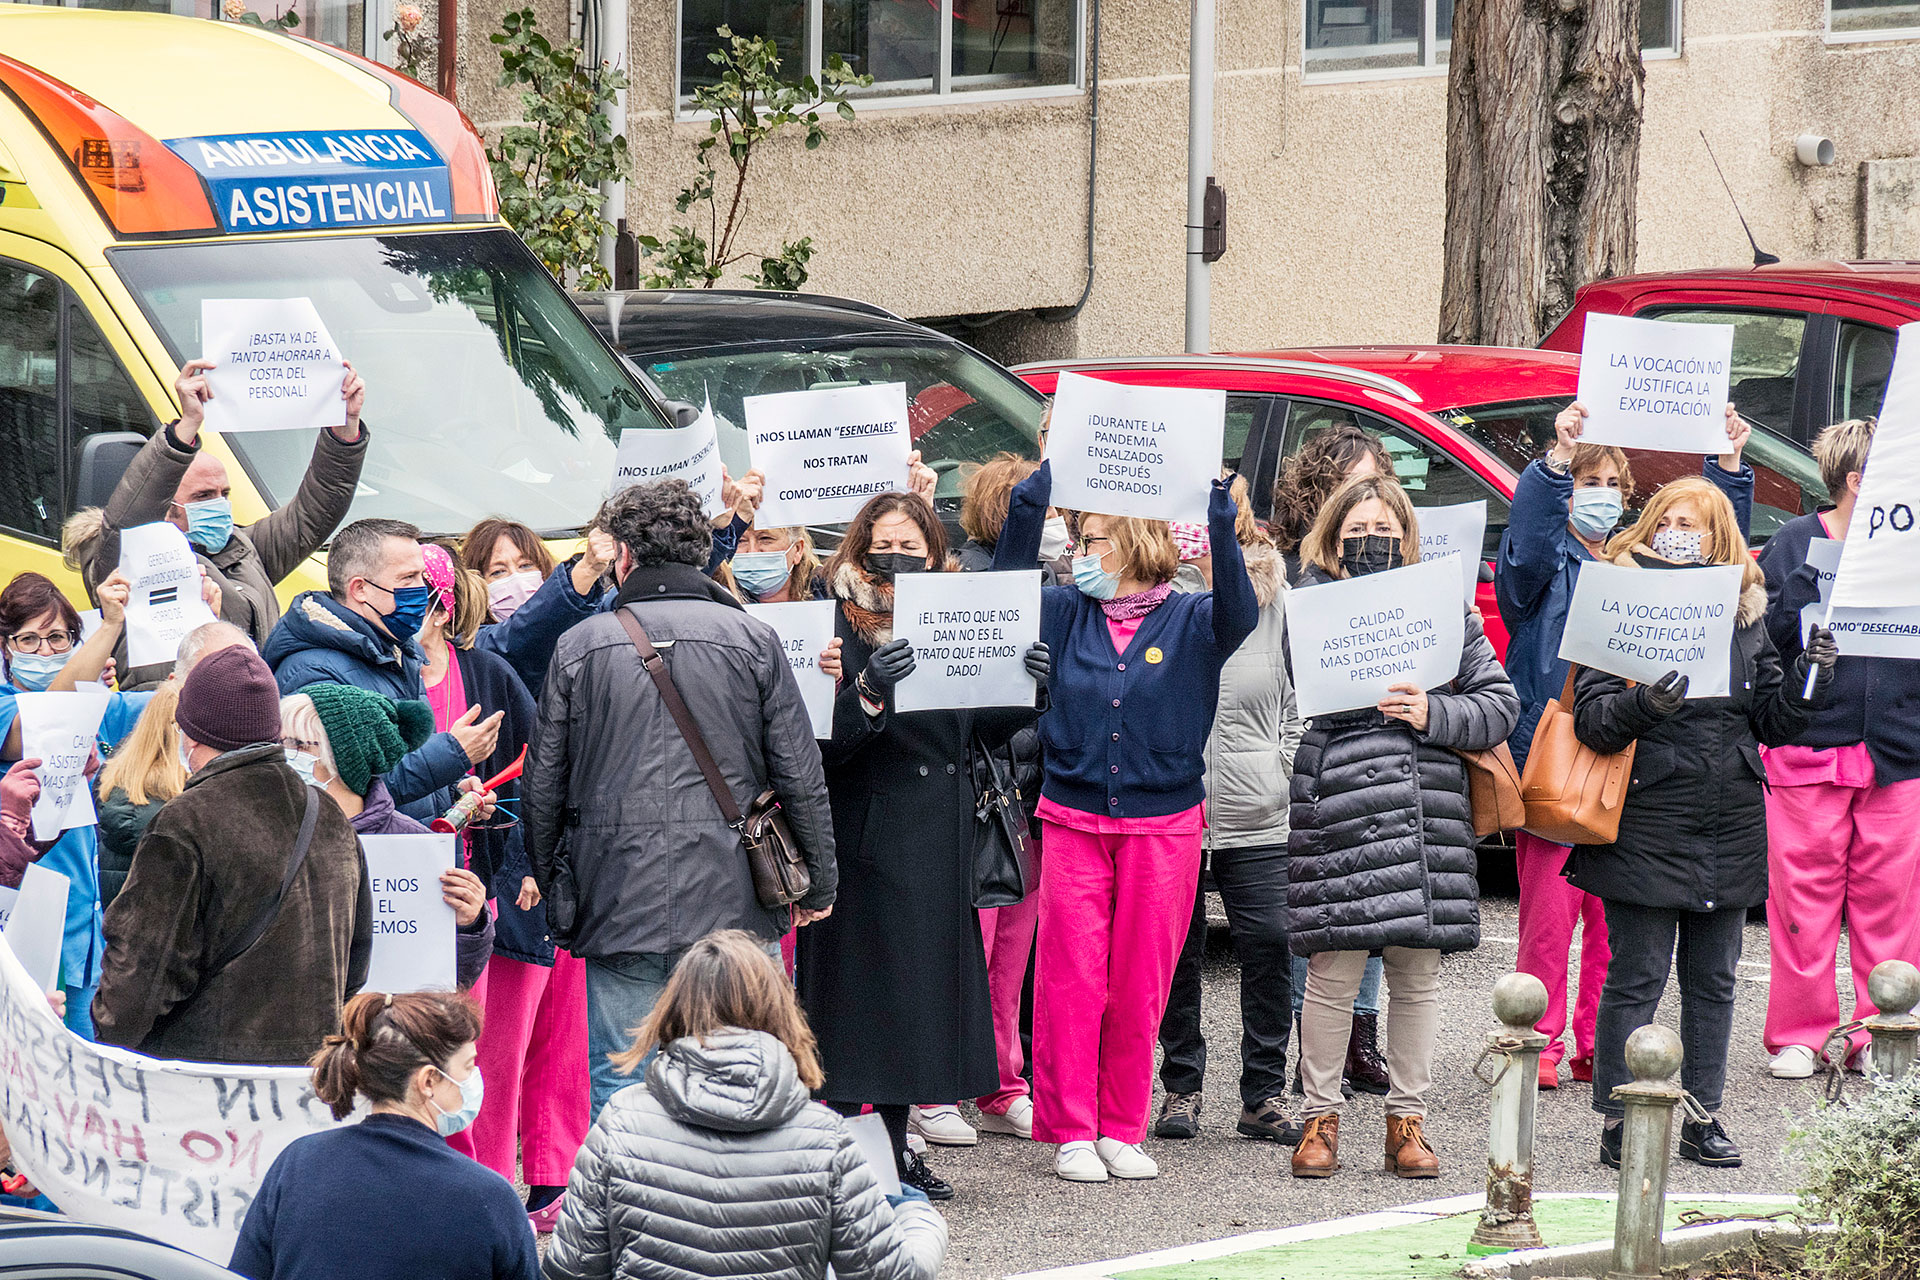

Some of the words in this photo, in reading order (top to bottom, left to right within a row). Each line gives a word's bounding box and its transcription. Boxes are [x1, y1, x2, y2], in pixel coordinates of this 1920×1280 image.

[199, 134, 431, 168] AMBULANCIA
[230, 181, 446, 226] ASISTENCIAL
[249, 333, 286, 346] ¡BASTA
[290, 333, 301, 343] YA
[305, 331, 317, 343] DE
[231, 351, 266, 363] TANTO
[268, 349, 321, 361] AHORRAR
[323, 349, 330, 360] A
[1610, 353, 1628, 368] LA
[1634, 356, 1704, 374] VOCACIÓN
[1708, 361, 1722, 374] NO
[250, 368, 283, 380] COSTA
[287, 366, 306, 378] DEL
[249, 385, 307, 398] PERSONAL!
[1625, 377, 1693, 395] JUSTIFICA
[1697, 382, 1710, 395] LA
[1620, 397, 1711, 416] EXPLOTACIÓN
[1089, 415, 1148, 431] ¡DURANTE
[1152, 422, 1166, 432] LA
[756, 432, 784, 444] ¡NOS
[788, 428, 831, 440] LLAMAN
[834, 421, 898, 438] “ESENCIALES”
[1095, 431, 1157, 448] PANDEMIA
[804, 458, 824, 469] NOS
[828, 454, 868, 466] TRATAN
[1088, 446, 1163, 464] ENSALZADOS
[618, 467, 648, 476] ¡NOS
[650, 459, 690, 476] LLAMAN
[1099, 463, 1150, 479] DESPUÉS
[1087, 477, 1162, 495] IGNORADOS!
[1436, 534, 1448, 546] DE
[919, 612, 934, 625] ¡EL
[938, 611, 970, 623] TRATO
[974, 610, 996, 623] QUE
[999, 610, 1019, 622] NOS
[1602, 599, 1620, 614] LA
[1627, 603, 1702, 620] VOCACIÓN
[1705, 604, 1724, 618] NO
[1350, 608, 1404, 629] CALIDAD
[934, 630, 956, 641] DAN
[959, 629, 975, 640] NO
[978, 628, 989, 640] ES
[992, 628, 1003, 640] EL
[1323, 626, 1403, 651] ASISTENCIAL
[1406, 618, 1432, 634] CON
[1615, 622, 1688, 641] JUSTIFICA
[1692, 627, 1705, 640] LA
[792, 640, 804, 651] DE
[917, 648, 949, 660] TRATO
[952, 647, 975, 660] QUE
[978, 646, 1016, 658] HEMOS
[1321, 654, 1350, 668] MAS
[1354, 639, 1419, 663] DOTACIÓN
[1423, 634, 1437, 648] DE
[1608, 638, 1705, 662] EXPLOTACIÓN
[807, 657, 814, 668] A
[946, 664, 982, 676] DADO!
[1350, 659, 1416, 681] PERSONAL
[42, 775, 64, 789] MAS
[386, 879, 418, 892] NOS
[379, 900, 396, 913] EL
[373, 920, 417, 934] EMOS
